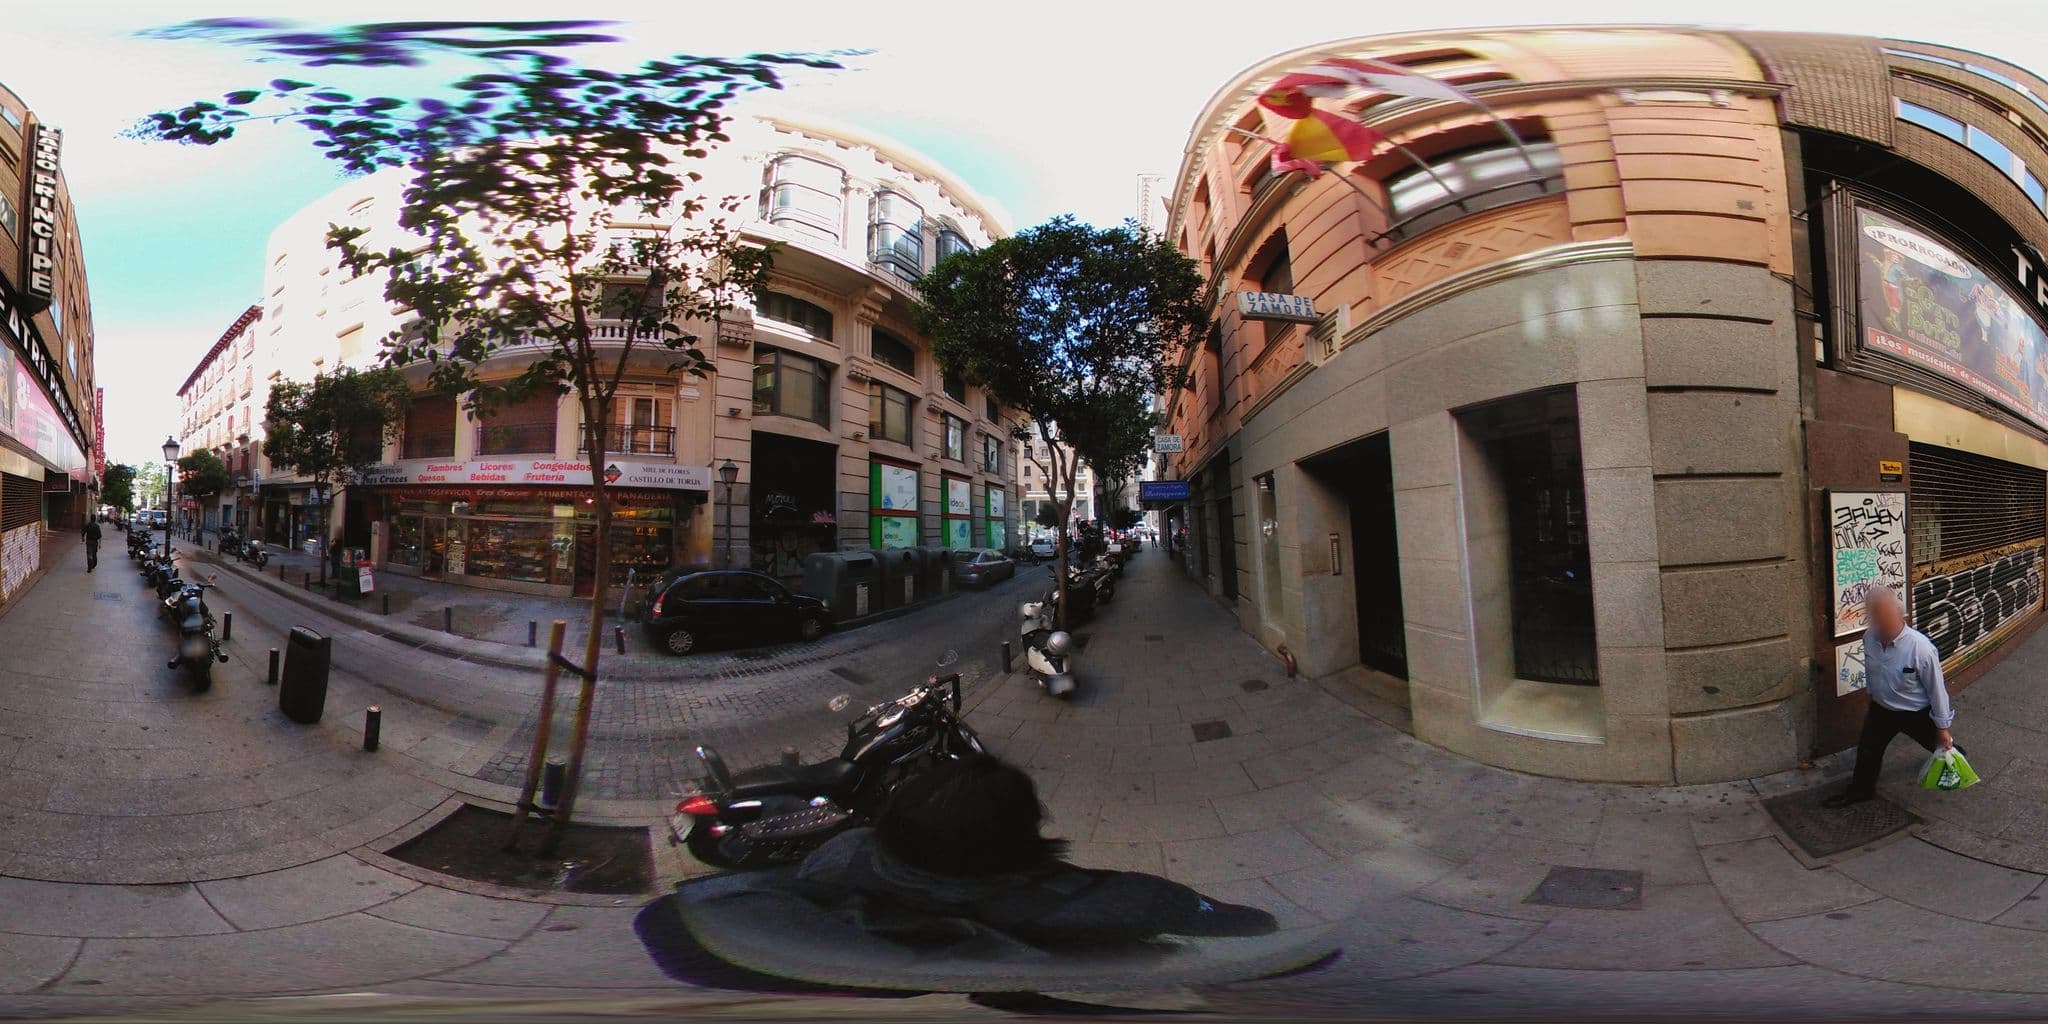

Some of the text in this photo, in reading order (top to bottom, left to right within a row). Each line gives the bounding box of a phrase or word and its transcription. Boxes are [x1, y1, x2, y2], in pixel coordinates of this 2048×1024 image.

[32, 174, 57, 294] PRINCIPE
[1246, 291, 1312, 307] CASA DE
[1248, 302, 1314, 318] ZAMORA
[1323, 336, 1334, 356] 12
[1908, 347, 1957, 374] musicales
[1158, 443, 1180, 451] ZAMORA
[426, 464, 463, 472] Fiambres
[479, 462, 513, 471] Licores
[532, 461, 593, 473] Congelados
[667, 467, 690, 475] FLORES
[379, 475, 408, 483] Cruces
[417, 474, 445, 482] Quesos
[470, 473, 506, 481] Bebidas
[629, 475, 664, 484] CASTILLO
